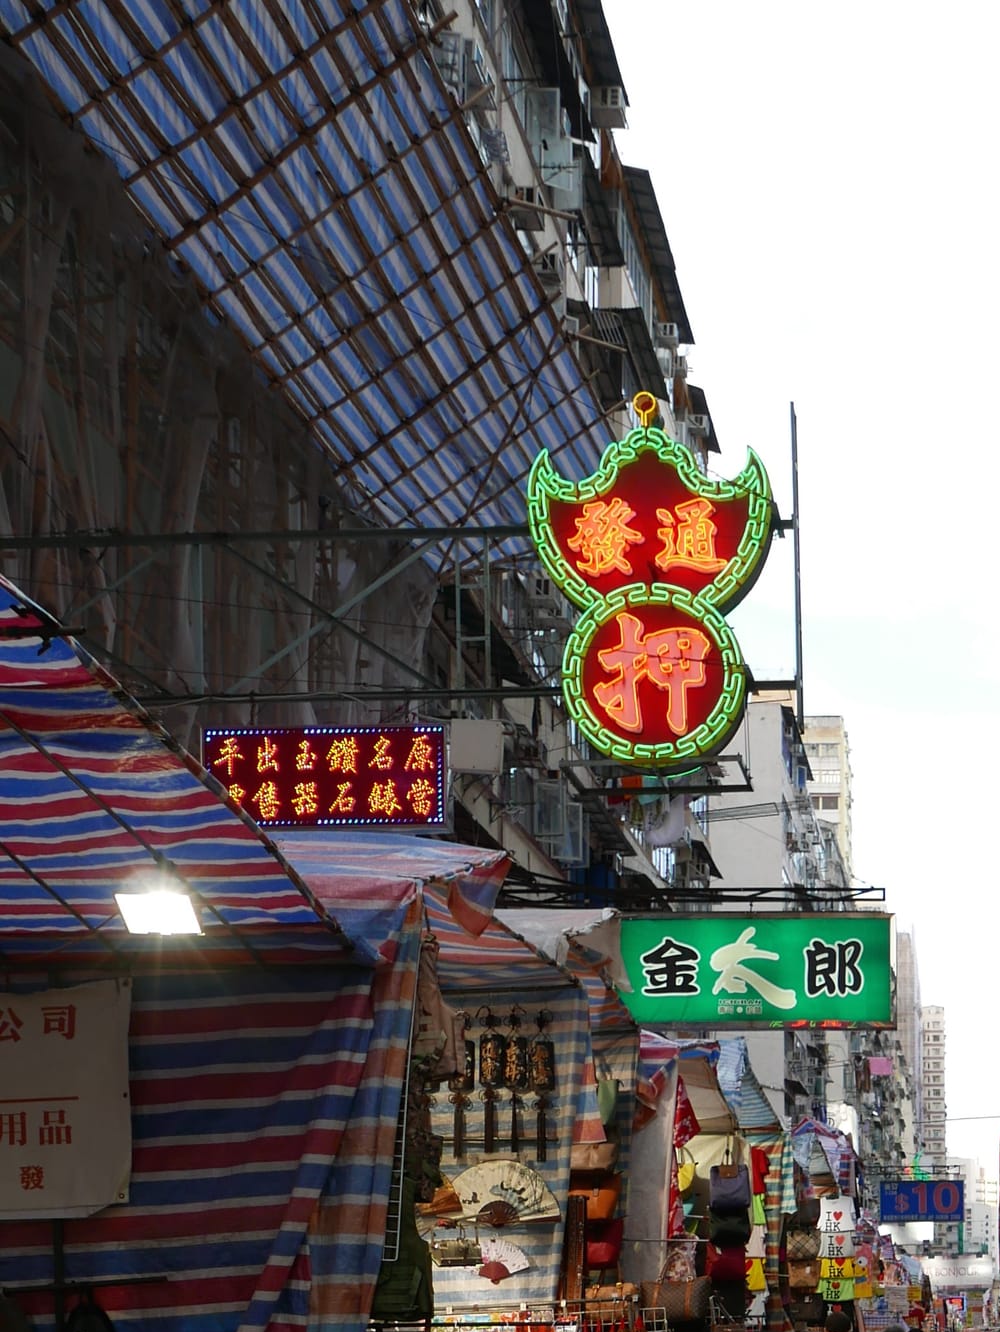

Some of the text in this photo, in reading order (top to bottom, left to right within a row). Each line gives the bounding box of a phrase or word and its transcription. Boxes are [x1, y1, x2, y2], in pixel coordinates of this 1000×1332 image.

[593, 612, 711, 736] 押
[641, 926, 864, 1010] 金太郎
[0, 1004, 77, 1043] 公司
[0, 1110, 73, 1146] 用品
[19, 1165, 45, 1191] 發
[895, 1182, 960, 1214] $10
[827, 1211, 832, 1222] I
[825, 1222, 841, 1232] HK
[829, 1235, 834, 1246] I
[828, 1246, 844, 1256] HK
[829, 1257, 834, 1268] I
[829, 1268, 845, 1278] HK
[827, 1281, 832, 1291] I
[826, 1290, 841, 1299] HK
